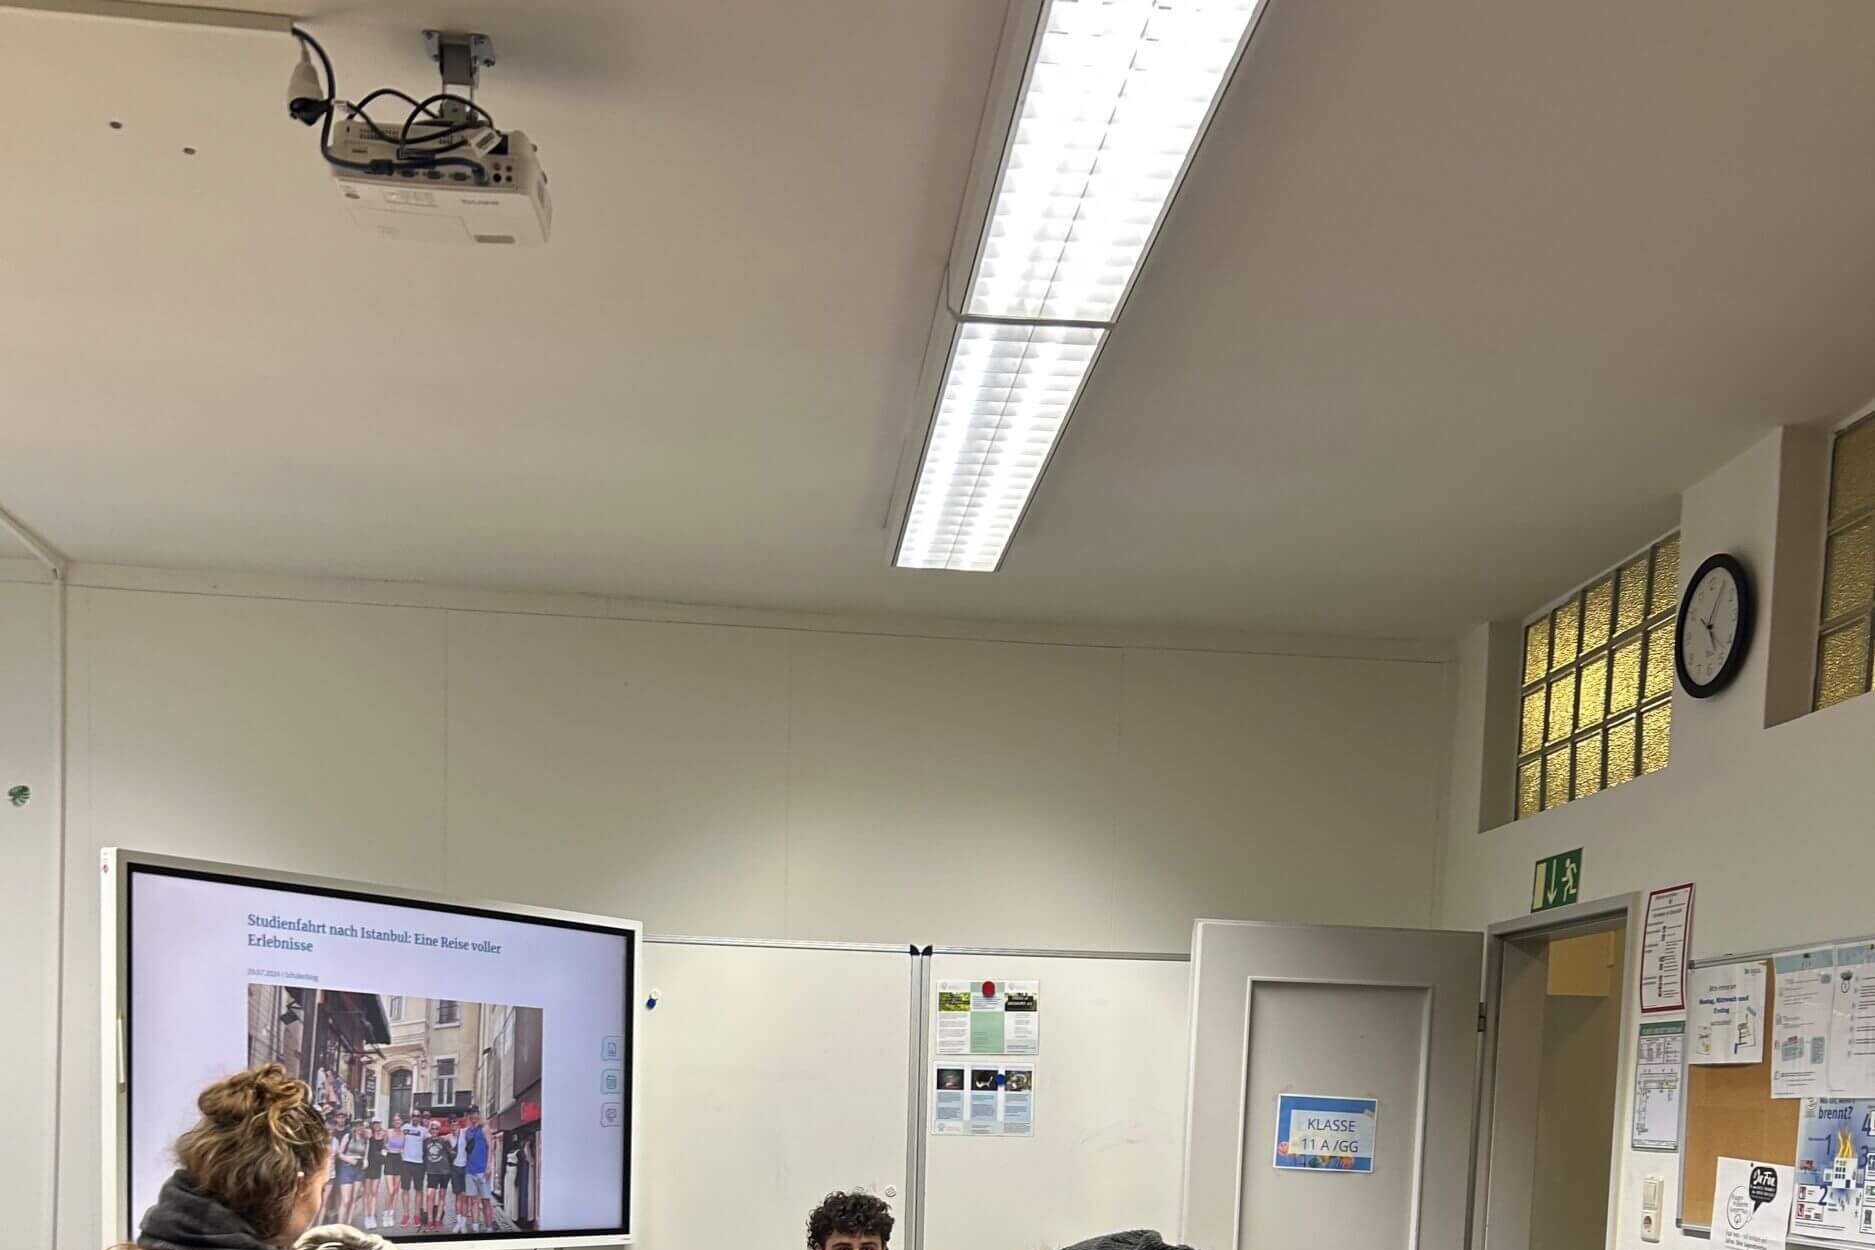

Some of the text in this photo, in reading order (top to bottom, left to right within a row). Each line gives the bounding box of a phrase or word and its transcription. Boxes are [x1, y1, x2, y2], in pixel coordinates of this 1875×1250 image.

[247, 913, 502, 954] Studienfahrt nach Istanbul: Eine Reise voller
[247, 933, 313, 952] Erlebnisse
[1818, 1106, 1854, 1120] brennt?
[1307, 1118, 1356, 1132] KLASSE
[1301, 1138, 1315, 1150] 11
[1320, 1139, 1330, 1151] A
[1818, 1185, 1828, 1206] 2
